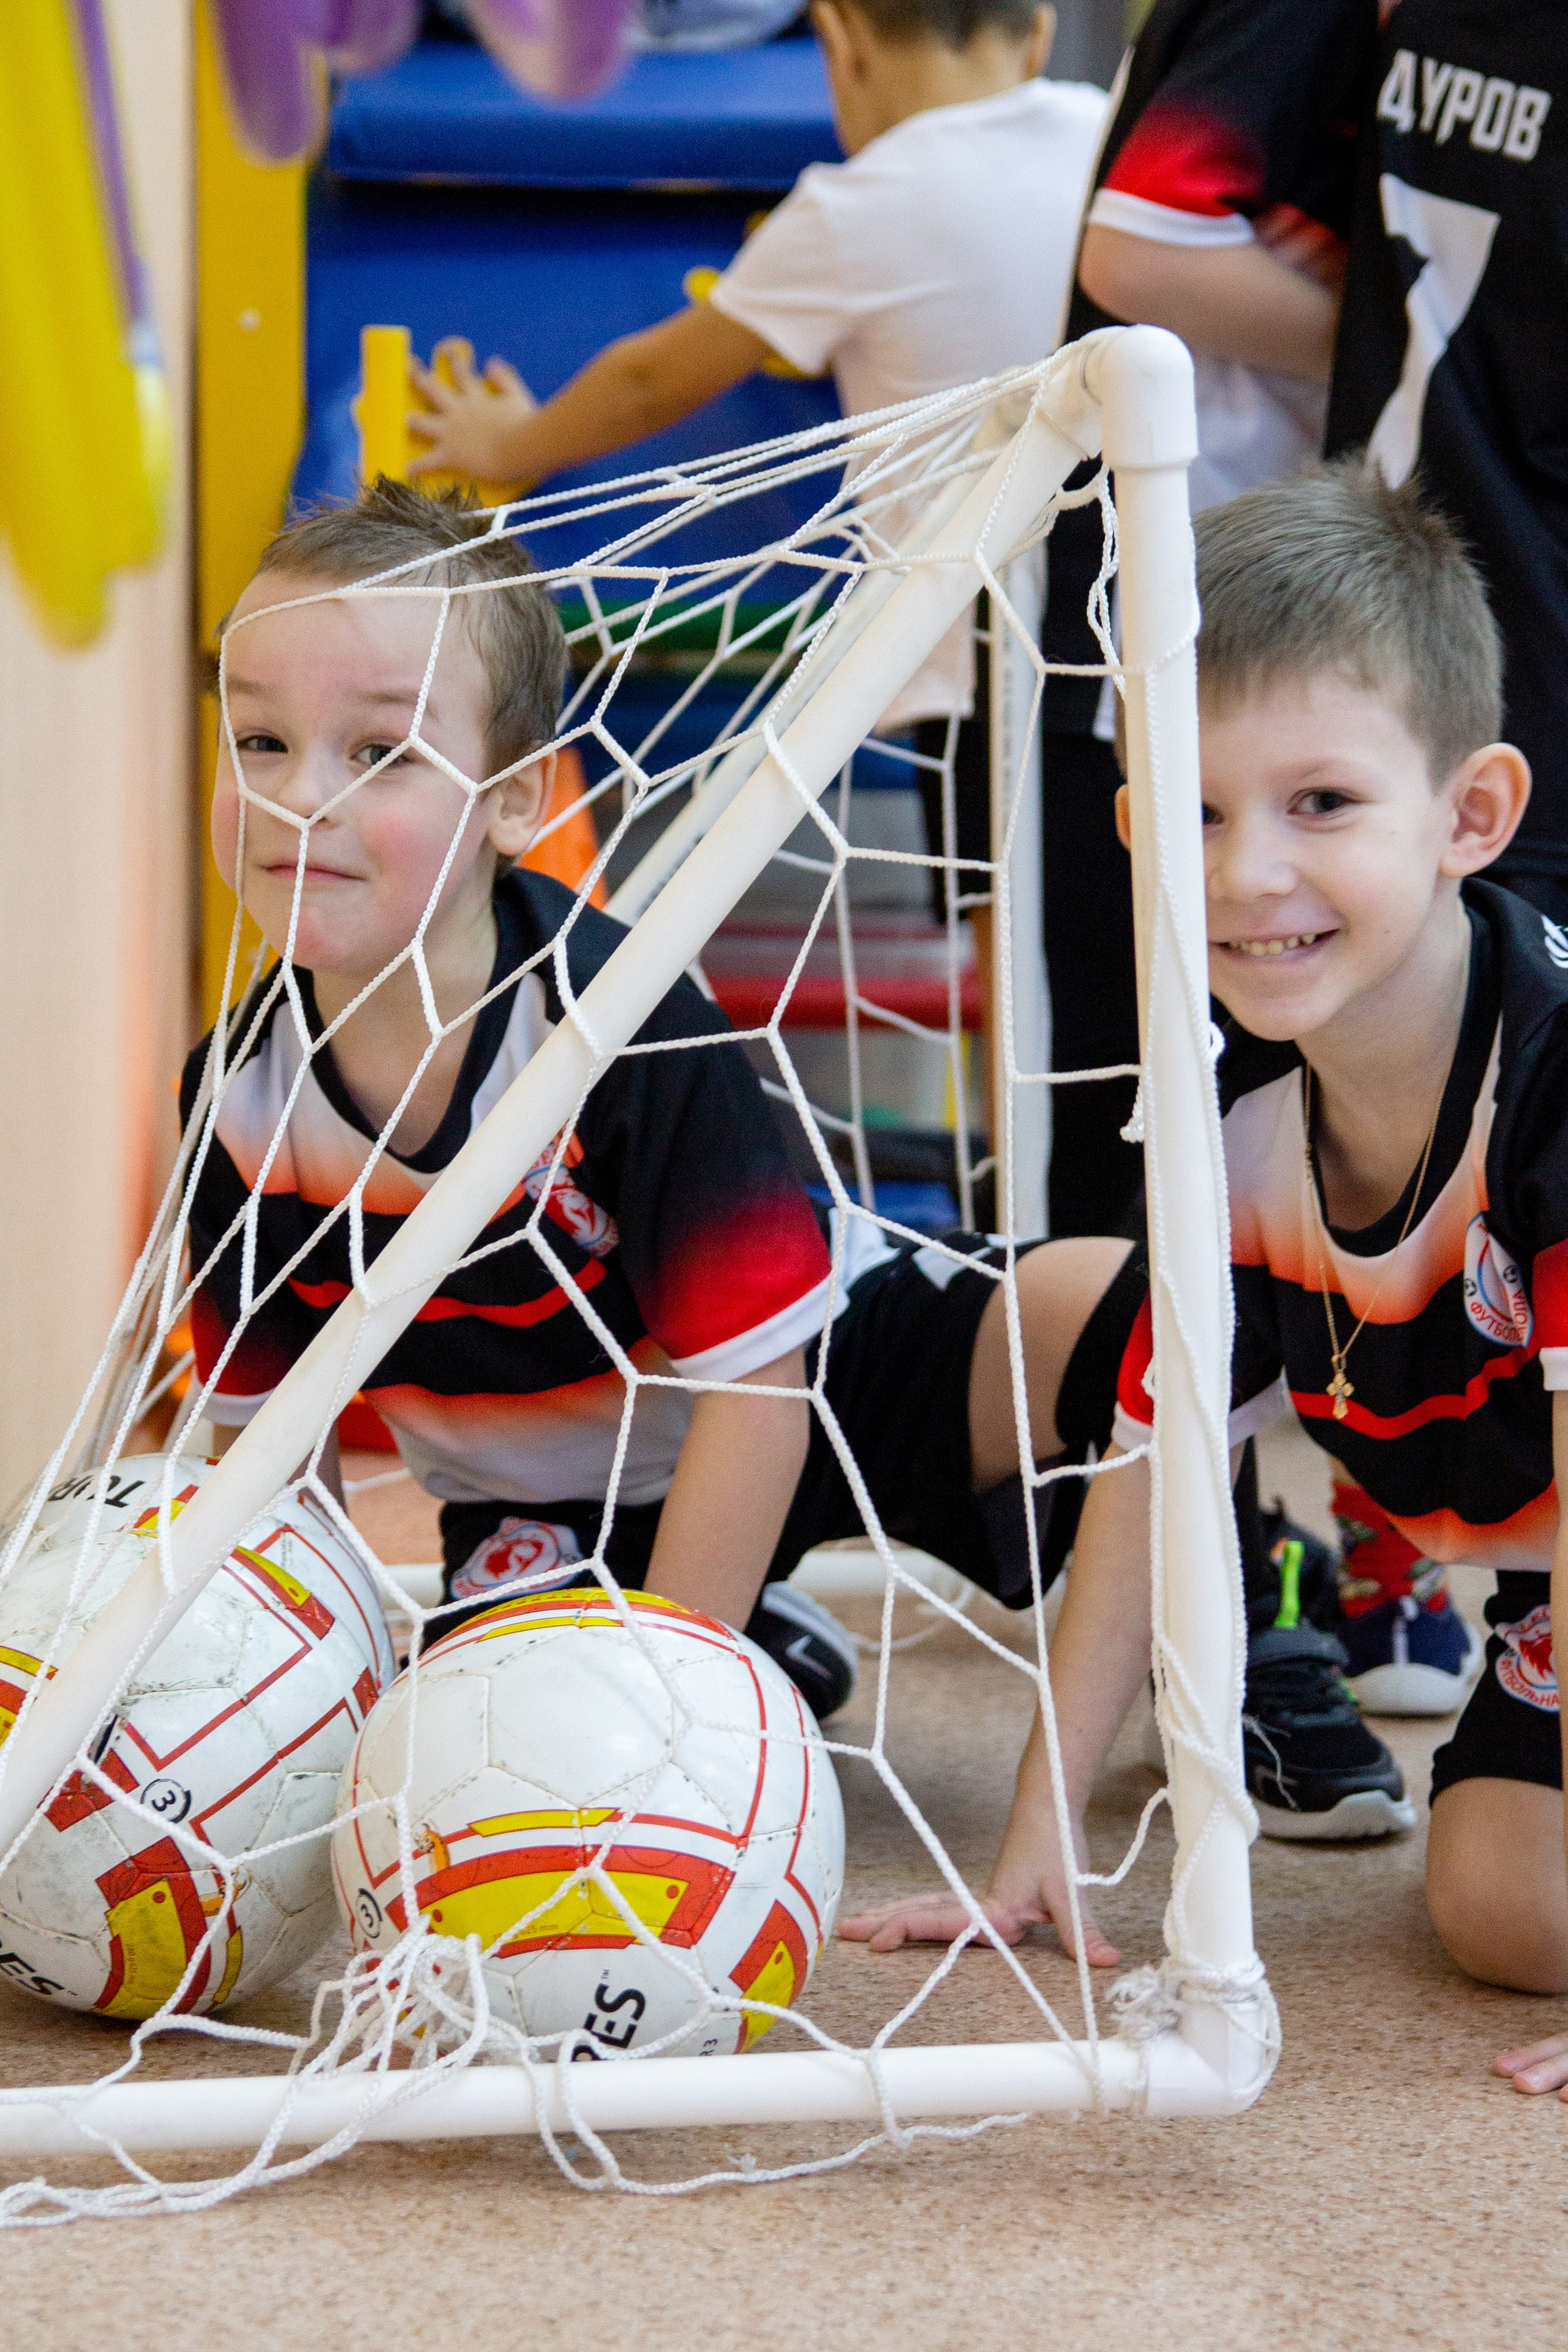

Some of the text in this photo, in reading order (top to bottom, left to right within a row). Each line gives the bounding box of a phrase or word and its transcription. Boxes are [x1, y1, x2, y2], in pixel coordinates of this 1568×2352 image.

[151, 1789, 176, 1812] 3
[360, 1903, 374, 1928] 3
[0, 1938, 64, 1996] ES
